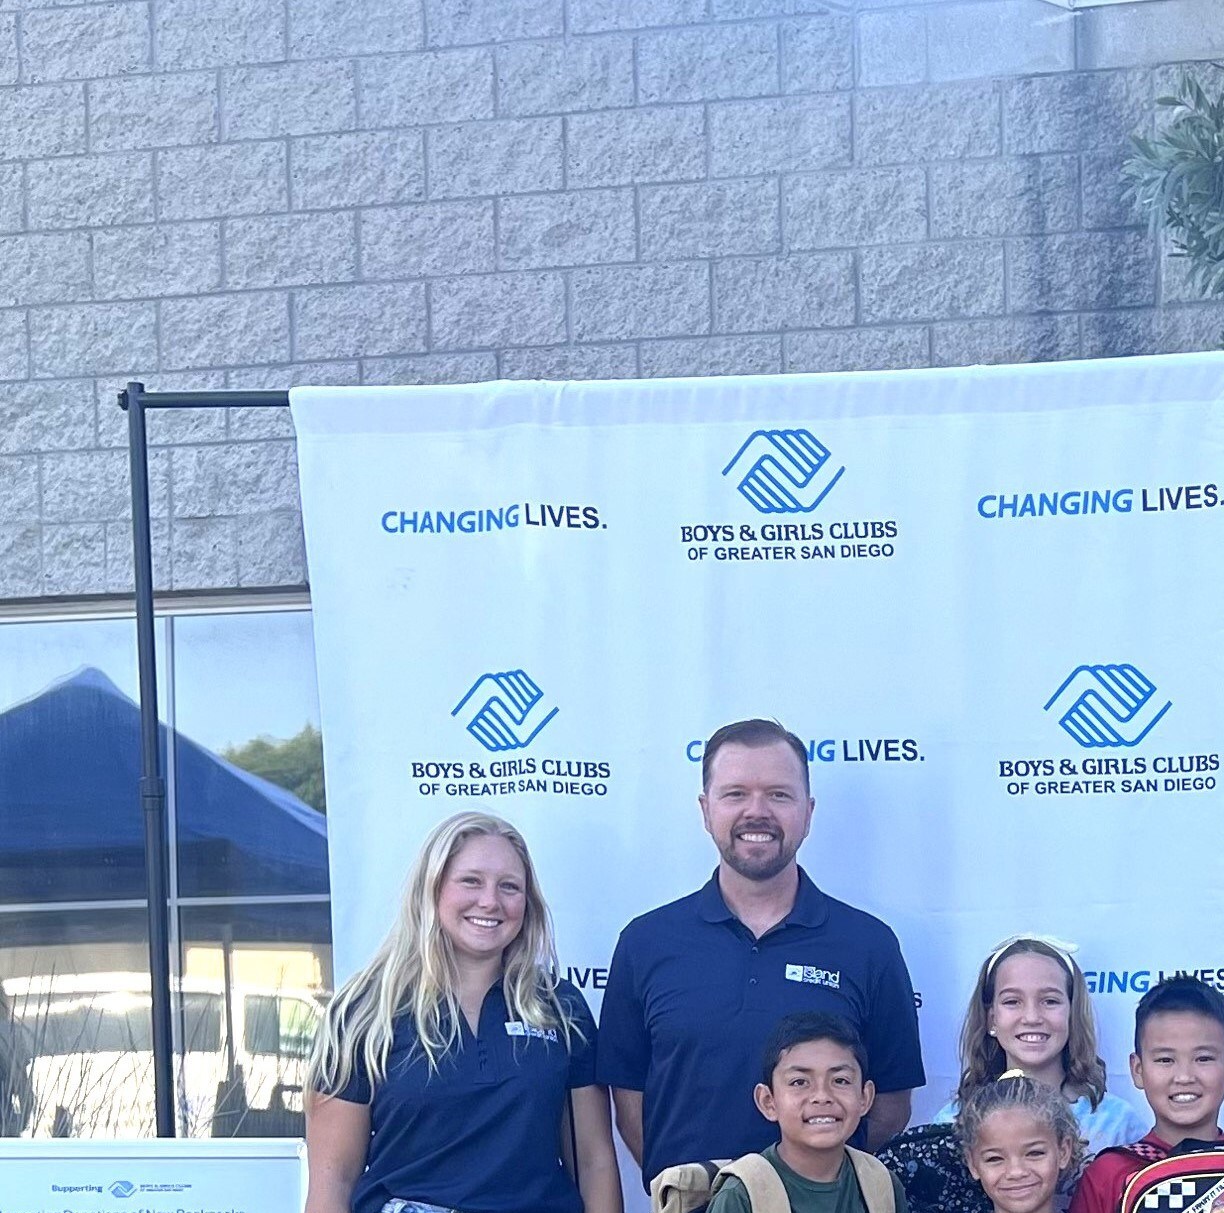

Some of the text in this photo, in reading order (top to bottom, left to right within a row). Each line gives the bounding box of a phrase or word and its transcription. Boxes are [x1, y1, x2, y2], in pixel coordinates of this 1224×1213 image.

[978, 484, 1224, 518] CHANGING LIVES.
[382, 503, 607, 533] CHANGING LIVES.
[681, 521, 897, 542] BOYS & GIRLS CLUBS
[688, 544, 894, 560] OF GREATER SAN DIEGO
[843, 739, 924, 761] LIVES.
[412, 758, 610, 778] BOYS & GIRLS CLUBS
[1000, 754, 1219, 777] BOYS & GIRLS CLUBS
[419, 779, 607, 795] OF GREATER SAN DIEGO
[1007, 777, 1215, 794] OF GREATER SAN DIEGO
[567, 966, 608, 989] IVE
[1083, 970, 1151, 993] GING
